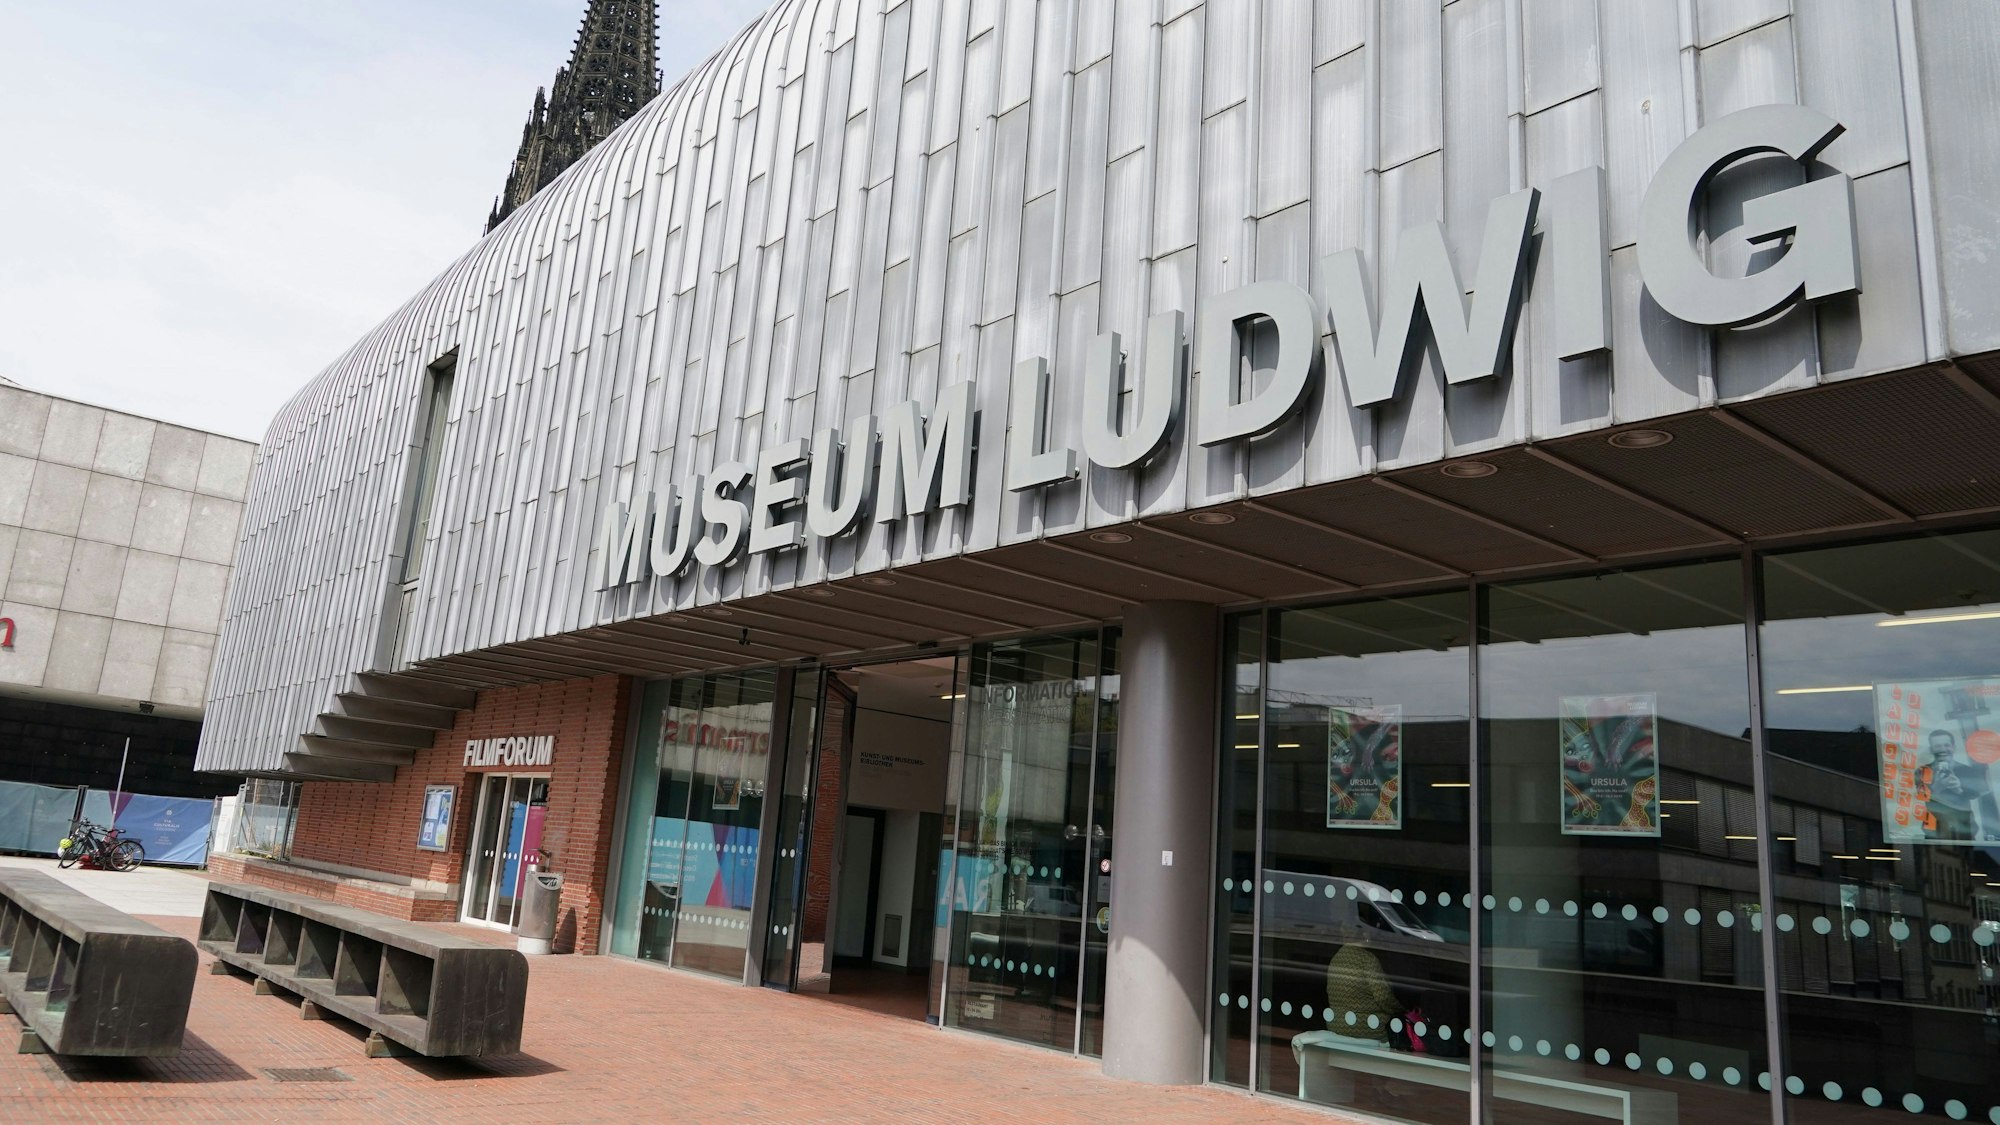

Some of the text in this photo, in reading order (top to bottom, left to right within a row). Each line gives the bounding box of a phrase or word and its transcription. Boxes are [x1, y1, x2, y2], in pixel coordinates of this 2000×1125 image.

[594, 104, 1862, 592] MUSEUM LUDWIG
[982, 680, 1088, 705] NFORMATION
[463, 735, 555, 767] FILMFORUM
[860, 758, 894, 768] BIBLIOTHEK
[1350, 778, 1378, 786] URSULA
[1591, 778, 1628, 786] URSULA
